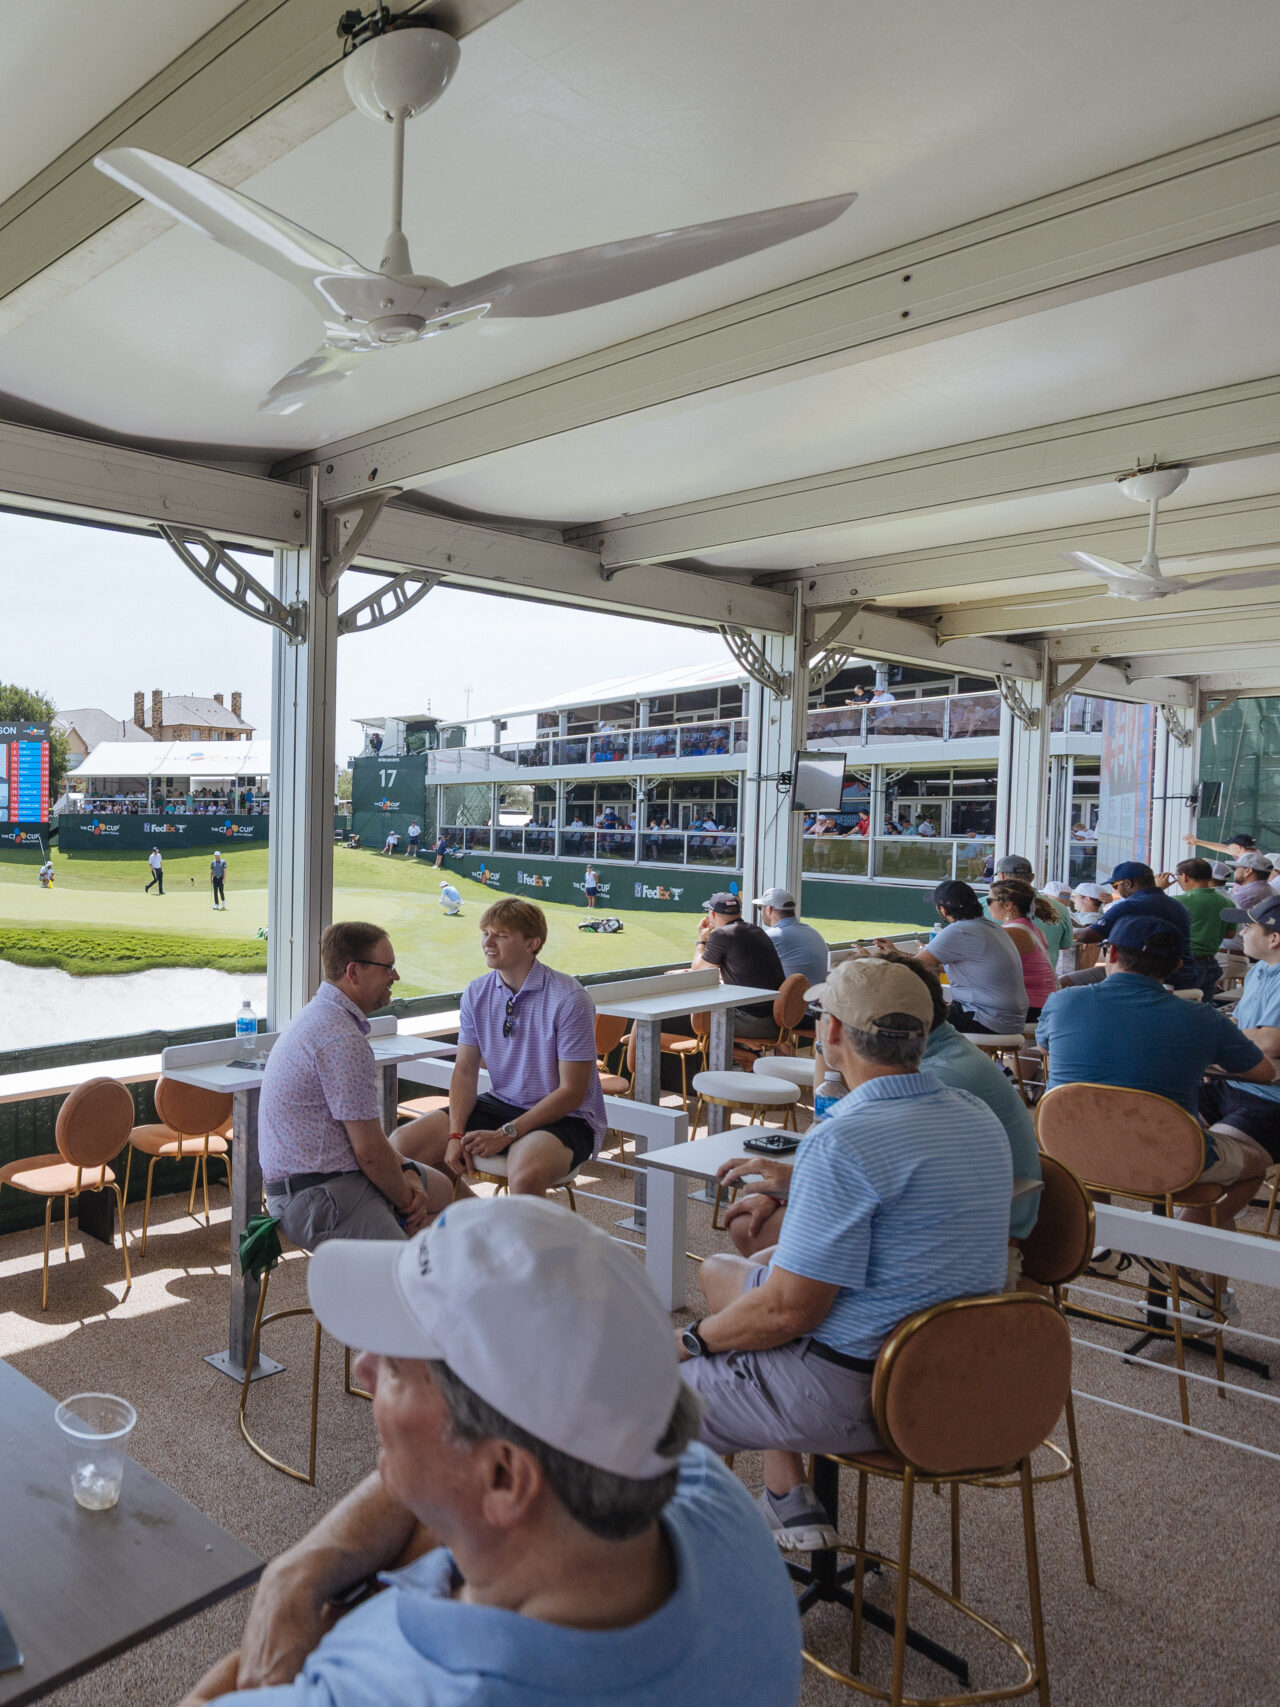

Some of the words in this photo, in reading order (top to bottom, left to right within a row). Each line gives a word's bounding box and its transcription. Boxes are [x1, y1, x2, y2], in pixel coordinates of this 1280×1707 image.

[378, 768, 397, 788] 17
[151, 824, 176, 833] FedEx
[490, 872, 500, 881] CUP
[523, 874, 544, 887] FedEx
[597, 883, 610, 892] CUP
[642, 885, 670, 900] FedEx
